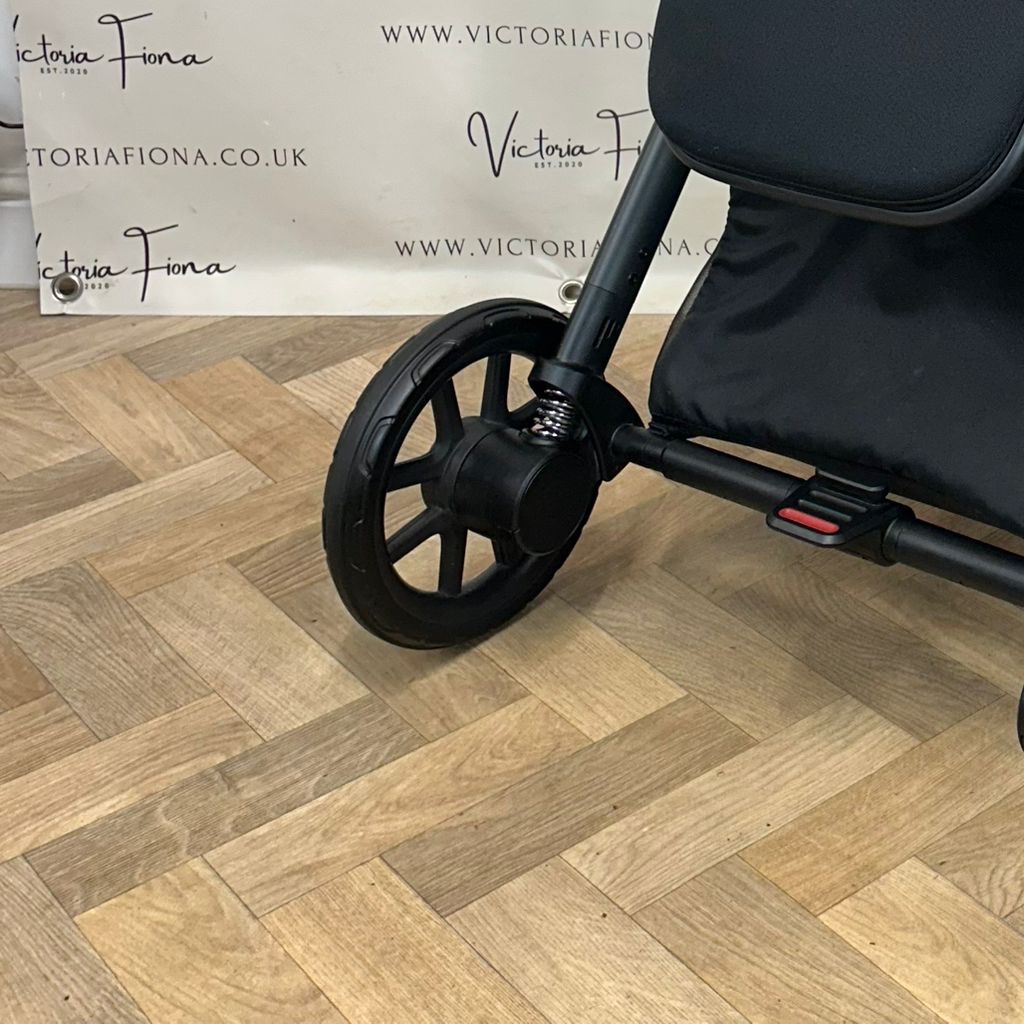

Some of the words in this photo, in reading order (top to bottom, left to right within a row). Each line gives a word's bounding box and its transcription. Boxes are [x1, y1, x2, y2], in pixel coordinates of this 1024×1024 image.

[13, 14, 104, 66] ictoria
[98, 12, 213, 89] Fiona
[467, 111, 600, 178] Victoria
[123, 224, 236, 302] Fiona
